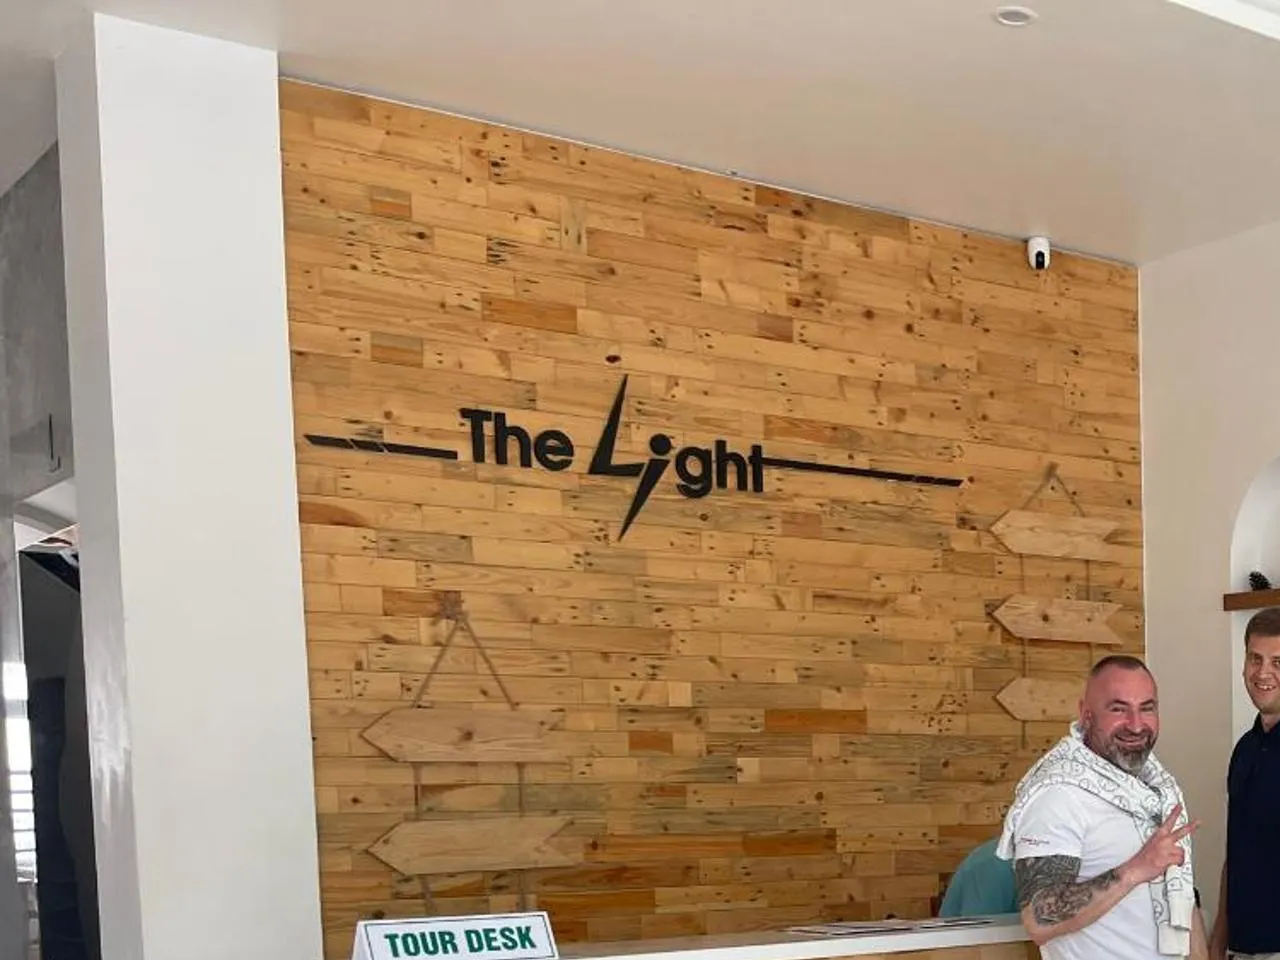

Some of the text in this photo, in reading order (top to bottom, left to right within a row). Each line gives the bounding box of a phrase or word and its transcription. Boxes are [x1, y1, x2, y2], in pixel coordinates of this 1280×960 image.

[459, 373, 765, 542] The Light
[384, 926, 537, 958] TOUR DESK
